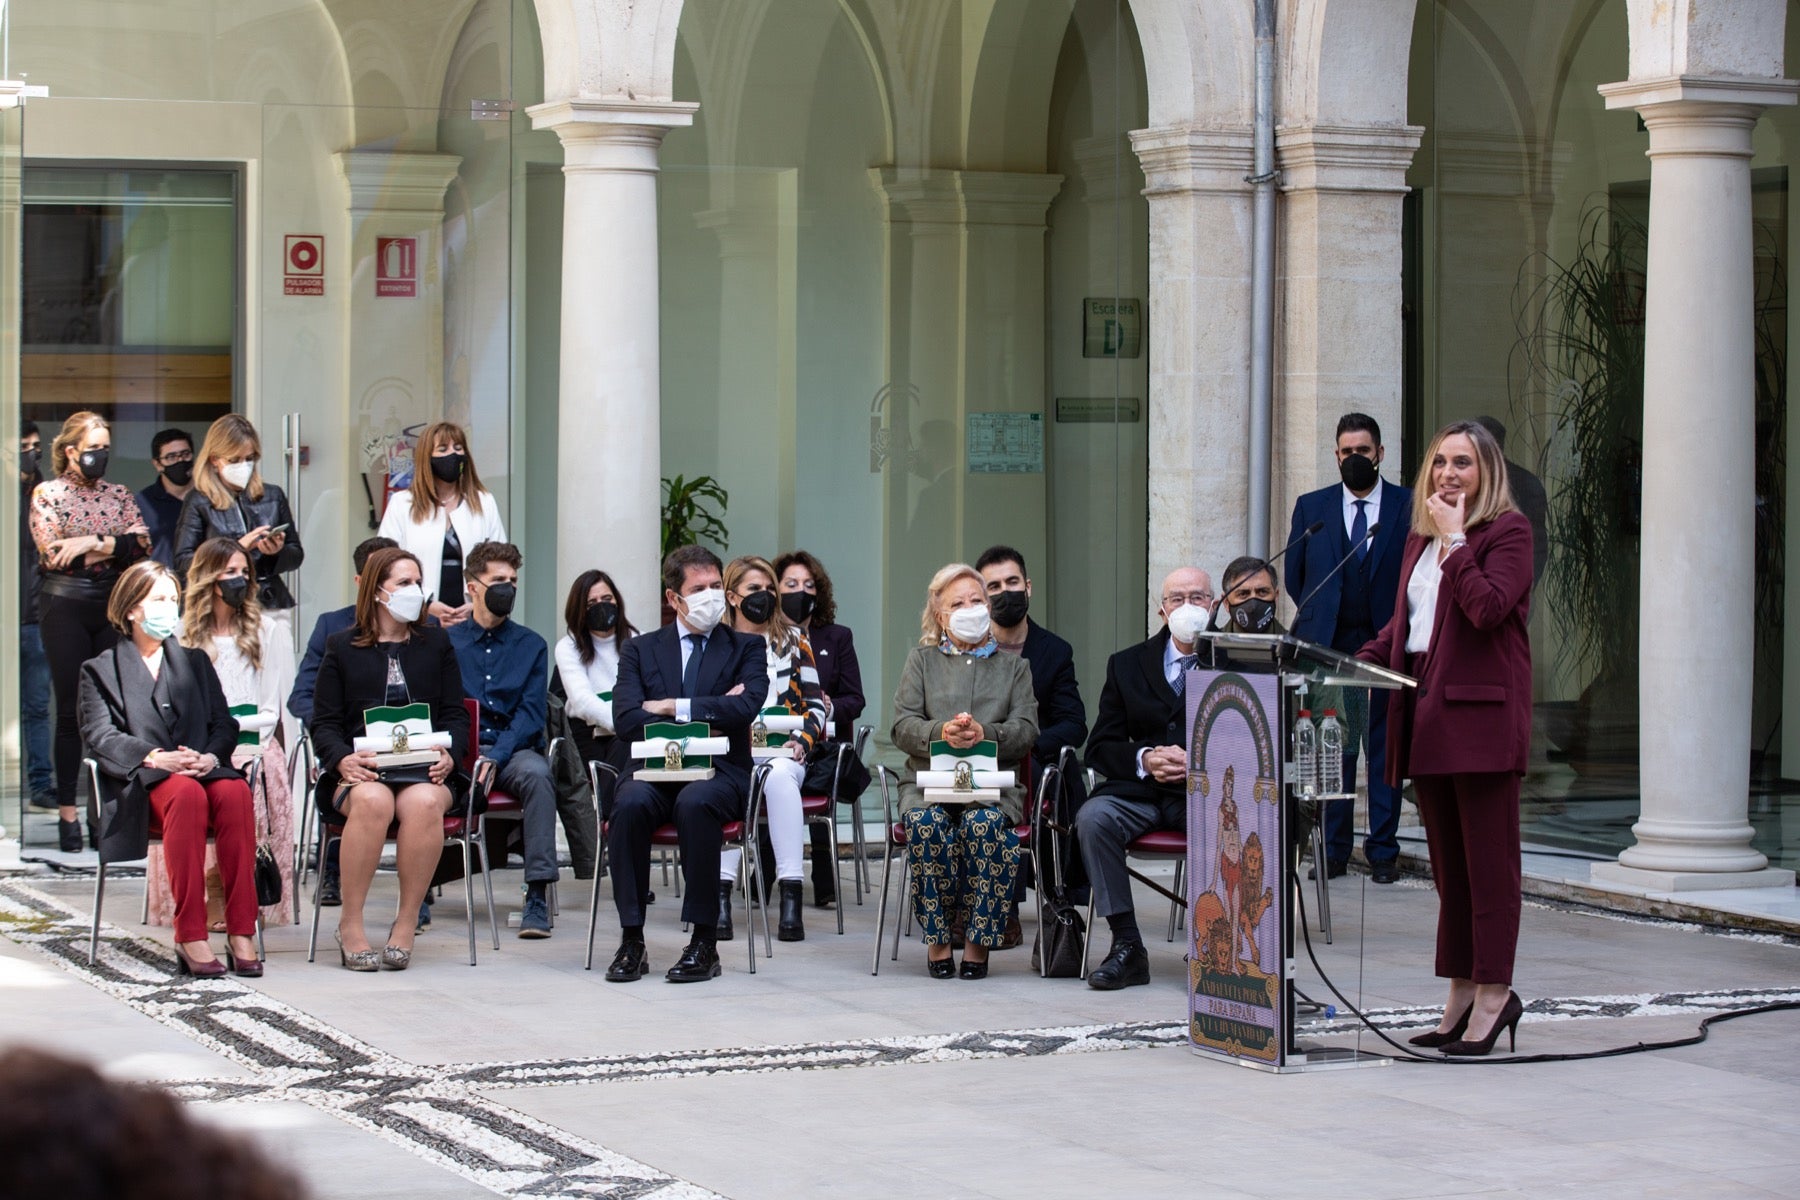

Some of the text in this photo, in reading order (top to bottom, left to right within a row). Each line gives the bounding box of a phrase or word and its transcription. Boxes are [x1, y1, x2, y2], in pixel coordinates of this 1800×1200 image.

[1092, 302, 1134, 314] Escaera
[1104, 320, 1124, 354] D
[1209, 999, 1257, 1022] PARA ESPAÑA
